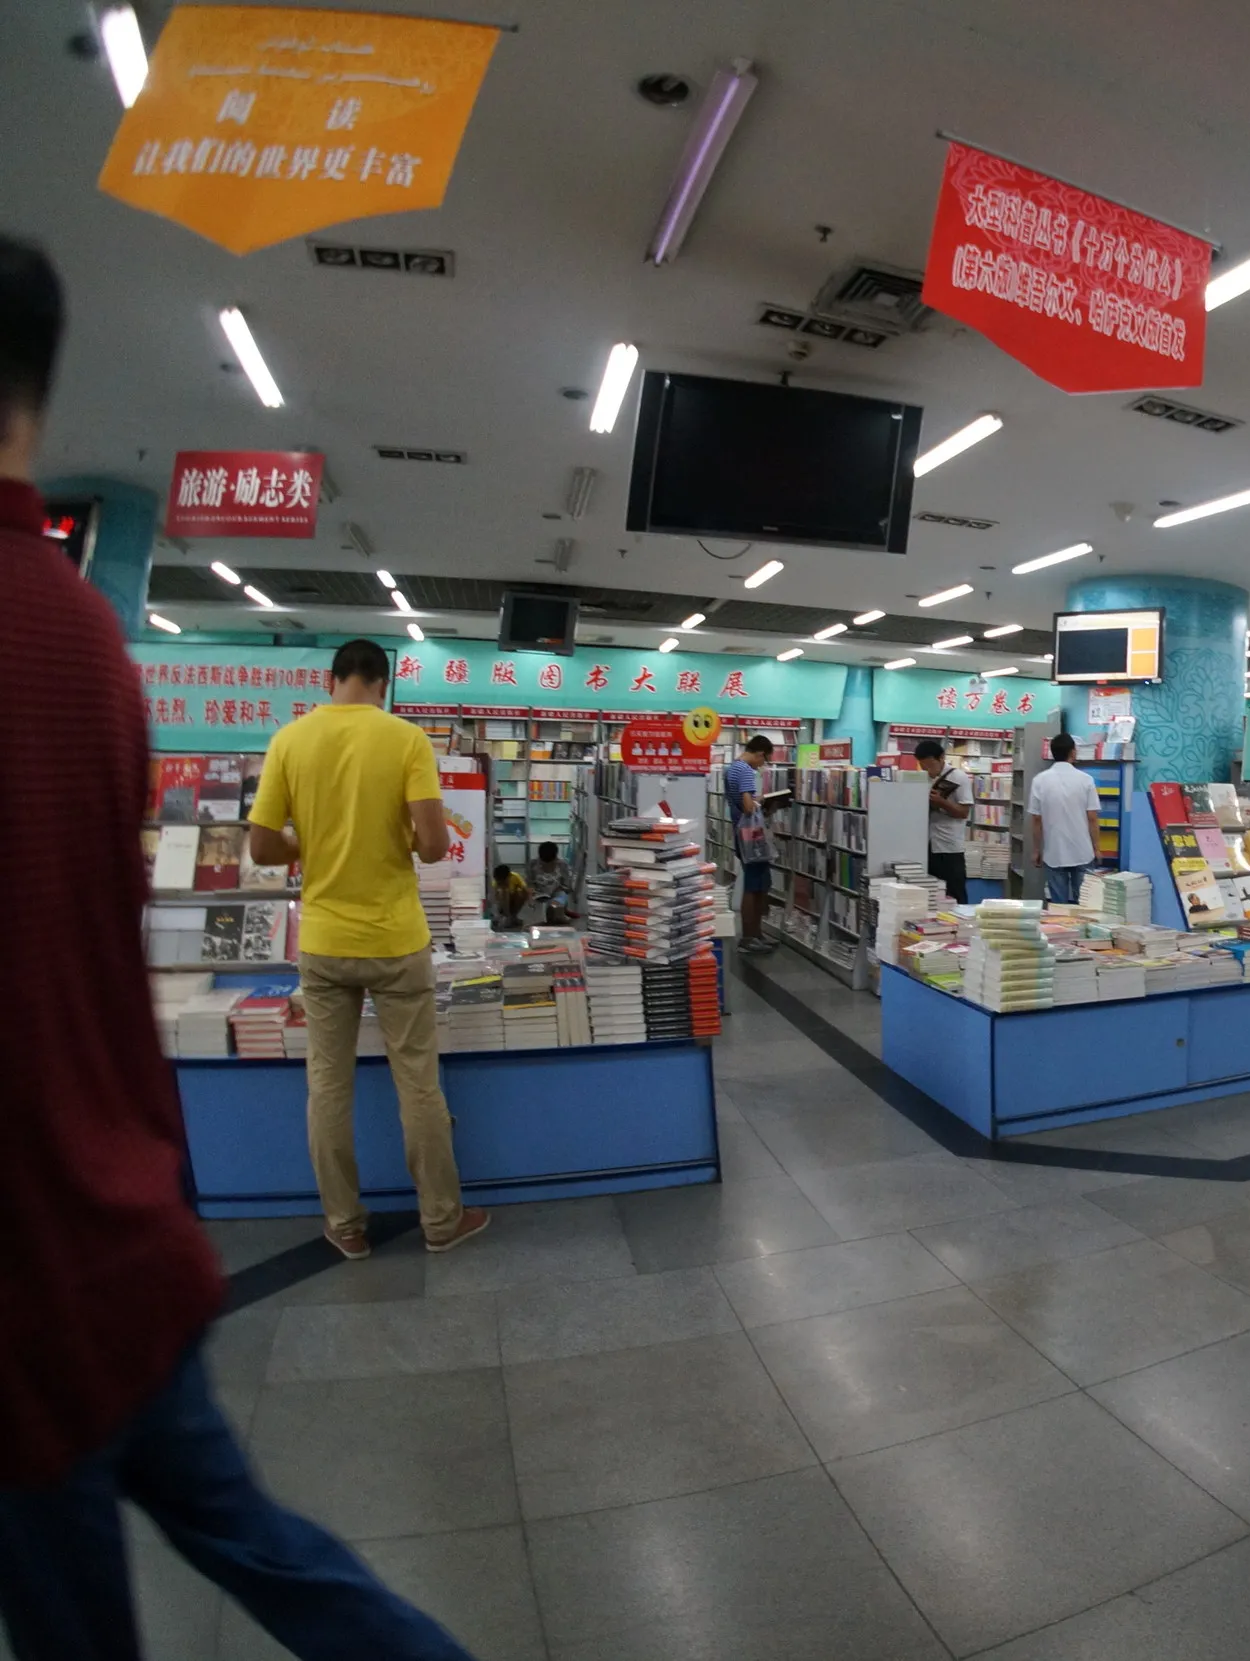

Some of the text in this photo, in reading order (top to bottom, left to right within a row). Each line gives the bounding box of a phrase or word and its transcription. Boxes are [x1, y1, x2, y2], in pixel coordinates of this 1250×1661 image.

[133, 137, 421, 188] 让我们的世界更丰富
[395, 655, 750, 698] 新疆版图书大联展
[143, 697, 317, 726] 先烈、珍爱和平、开
[936, 686, 1037, 715] 读万卷书
